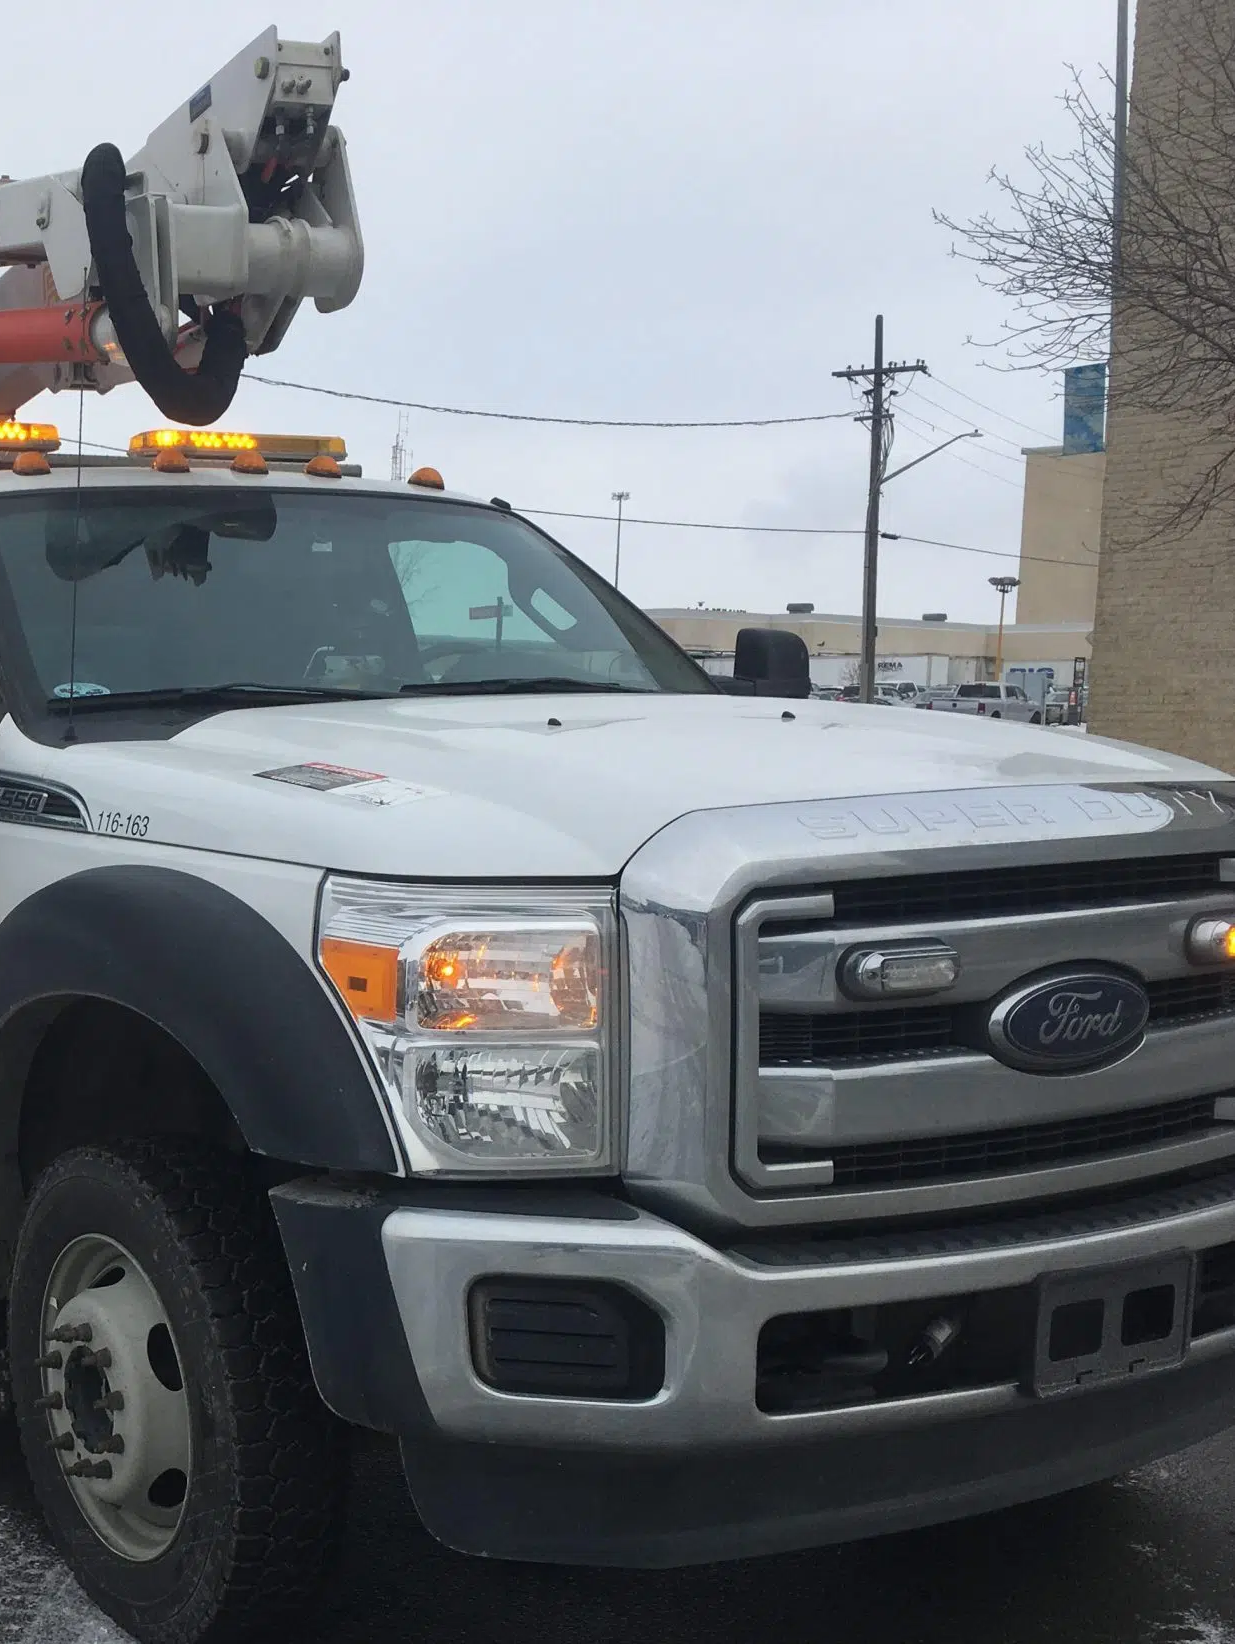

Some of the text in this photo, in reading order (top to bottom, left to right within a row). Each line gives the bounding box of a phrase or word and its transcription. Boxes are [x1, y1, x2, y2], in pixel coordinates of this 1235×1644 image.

[97, 810, 150, 837] 116-163
[797, 790, 1227, 840] SUPER DUTY
[1039, 990, 1125, 1045] Ford
